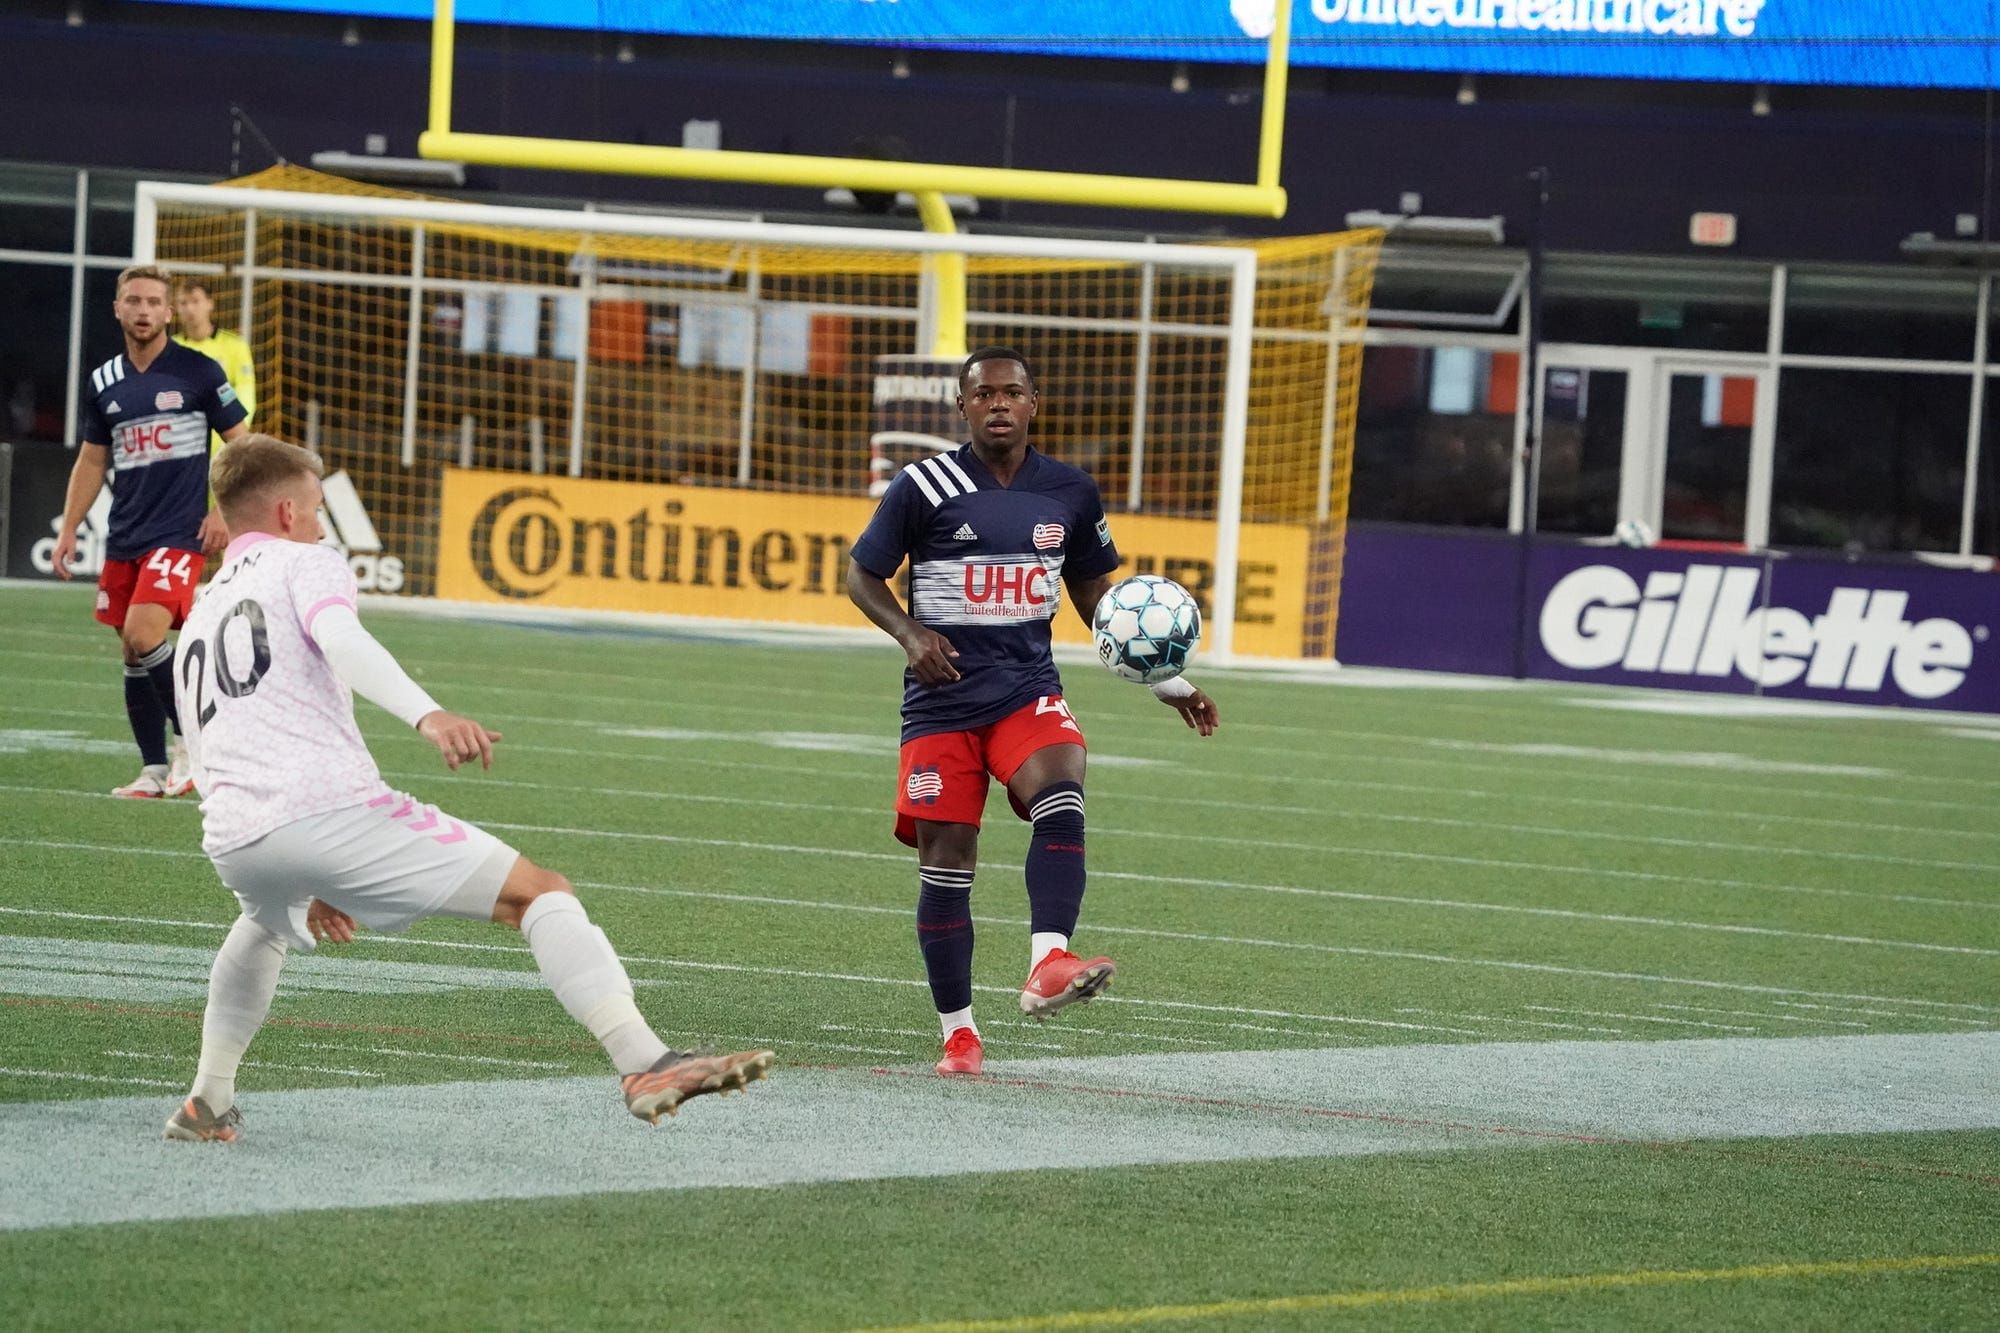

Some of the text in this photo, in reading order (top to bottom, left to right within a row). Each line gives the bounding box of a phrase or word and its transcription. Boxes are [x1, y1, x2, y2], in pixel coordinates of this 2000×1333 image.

[121, 424, 172, 453] UHC
[469, 485, 909, 602] Continen
[953, 533, 978, 541] adidas
[147, 546, 192, 586] 44
[964, 563, 1047, 605] UHC
[1539, 564, 1974, 699] Gillette
[183, 598, 271, 728] 20
